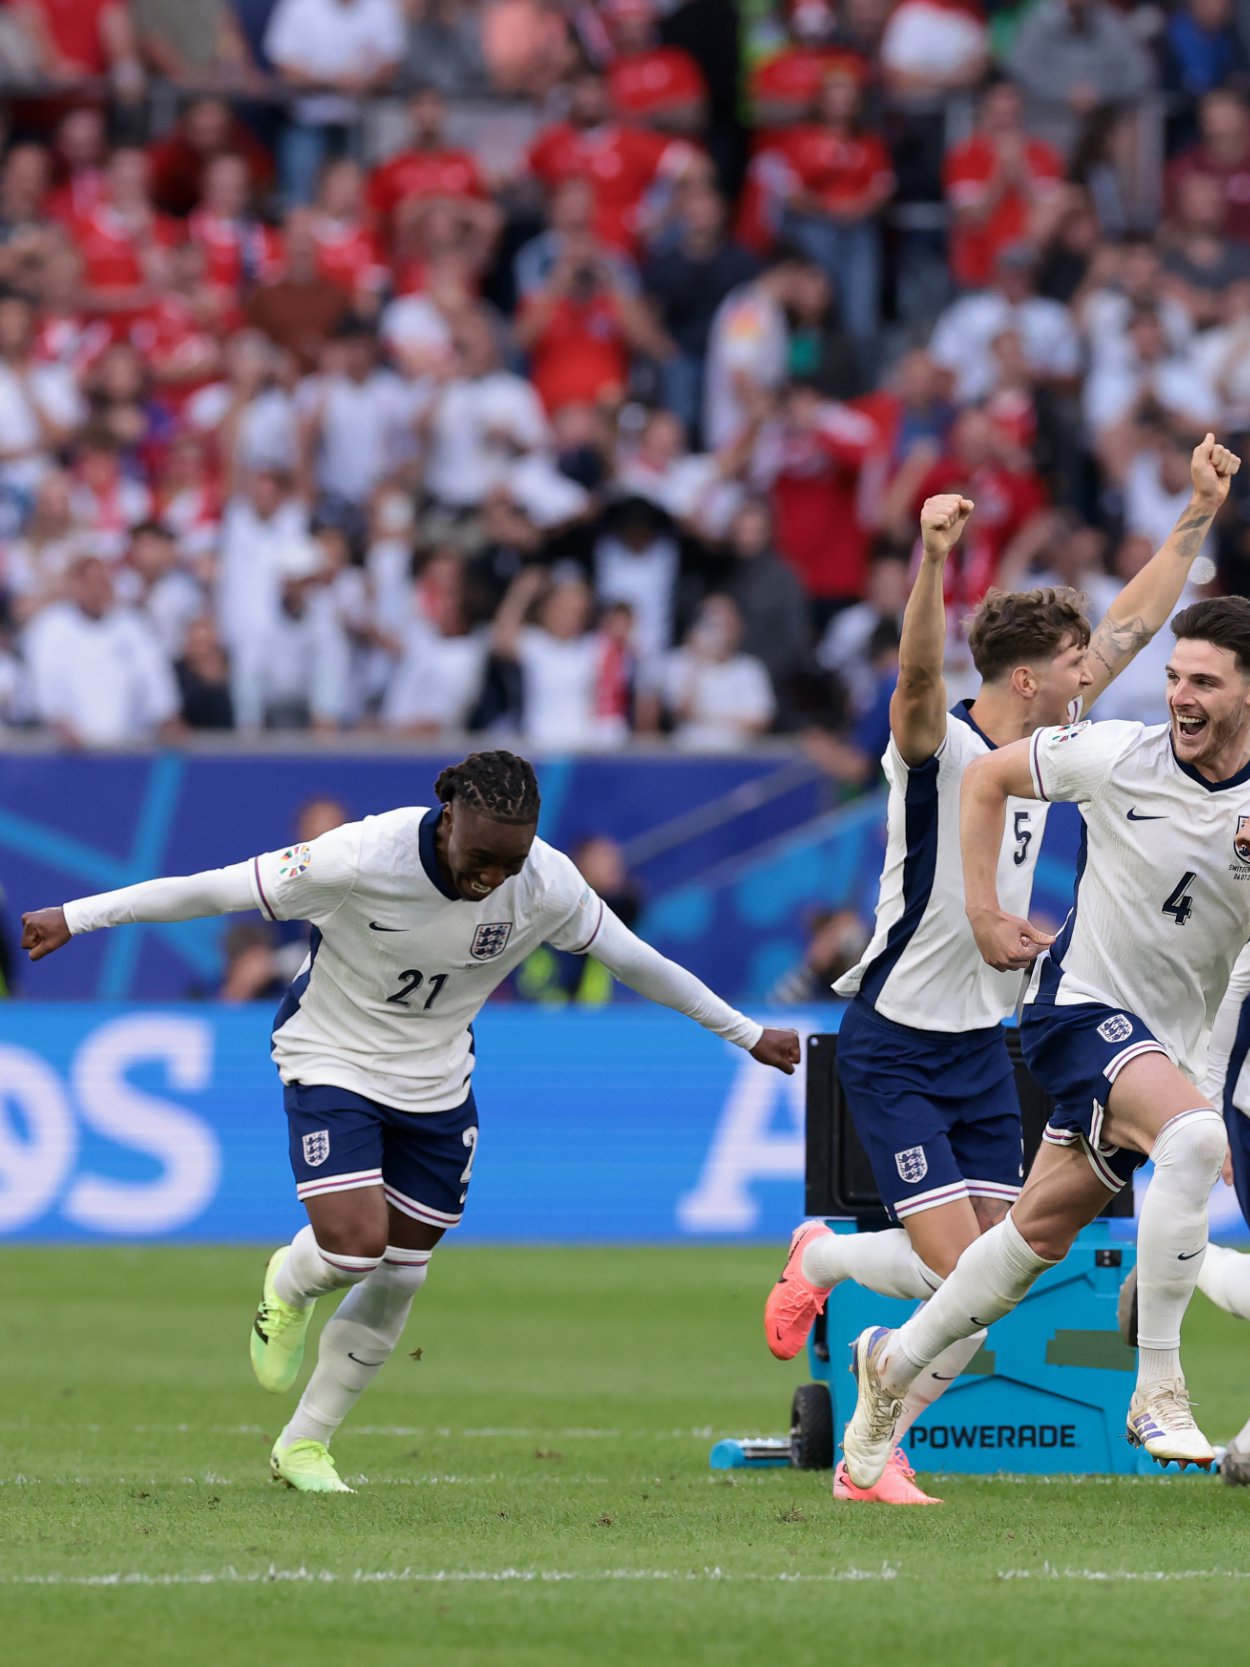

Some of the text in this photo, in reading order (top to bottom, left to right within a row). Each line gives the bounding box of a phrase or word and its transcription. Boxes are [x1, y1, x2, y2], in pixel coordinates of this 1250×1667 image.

[1013, 811, 1032, 867] 5
[1162, 871, 1197, 926] 4
[385, 969, 449, 1010] 21
[909, 1424, 1076, 1449] POWERADE
